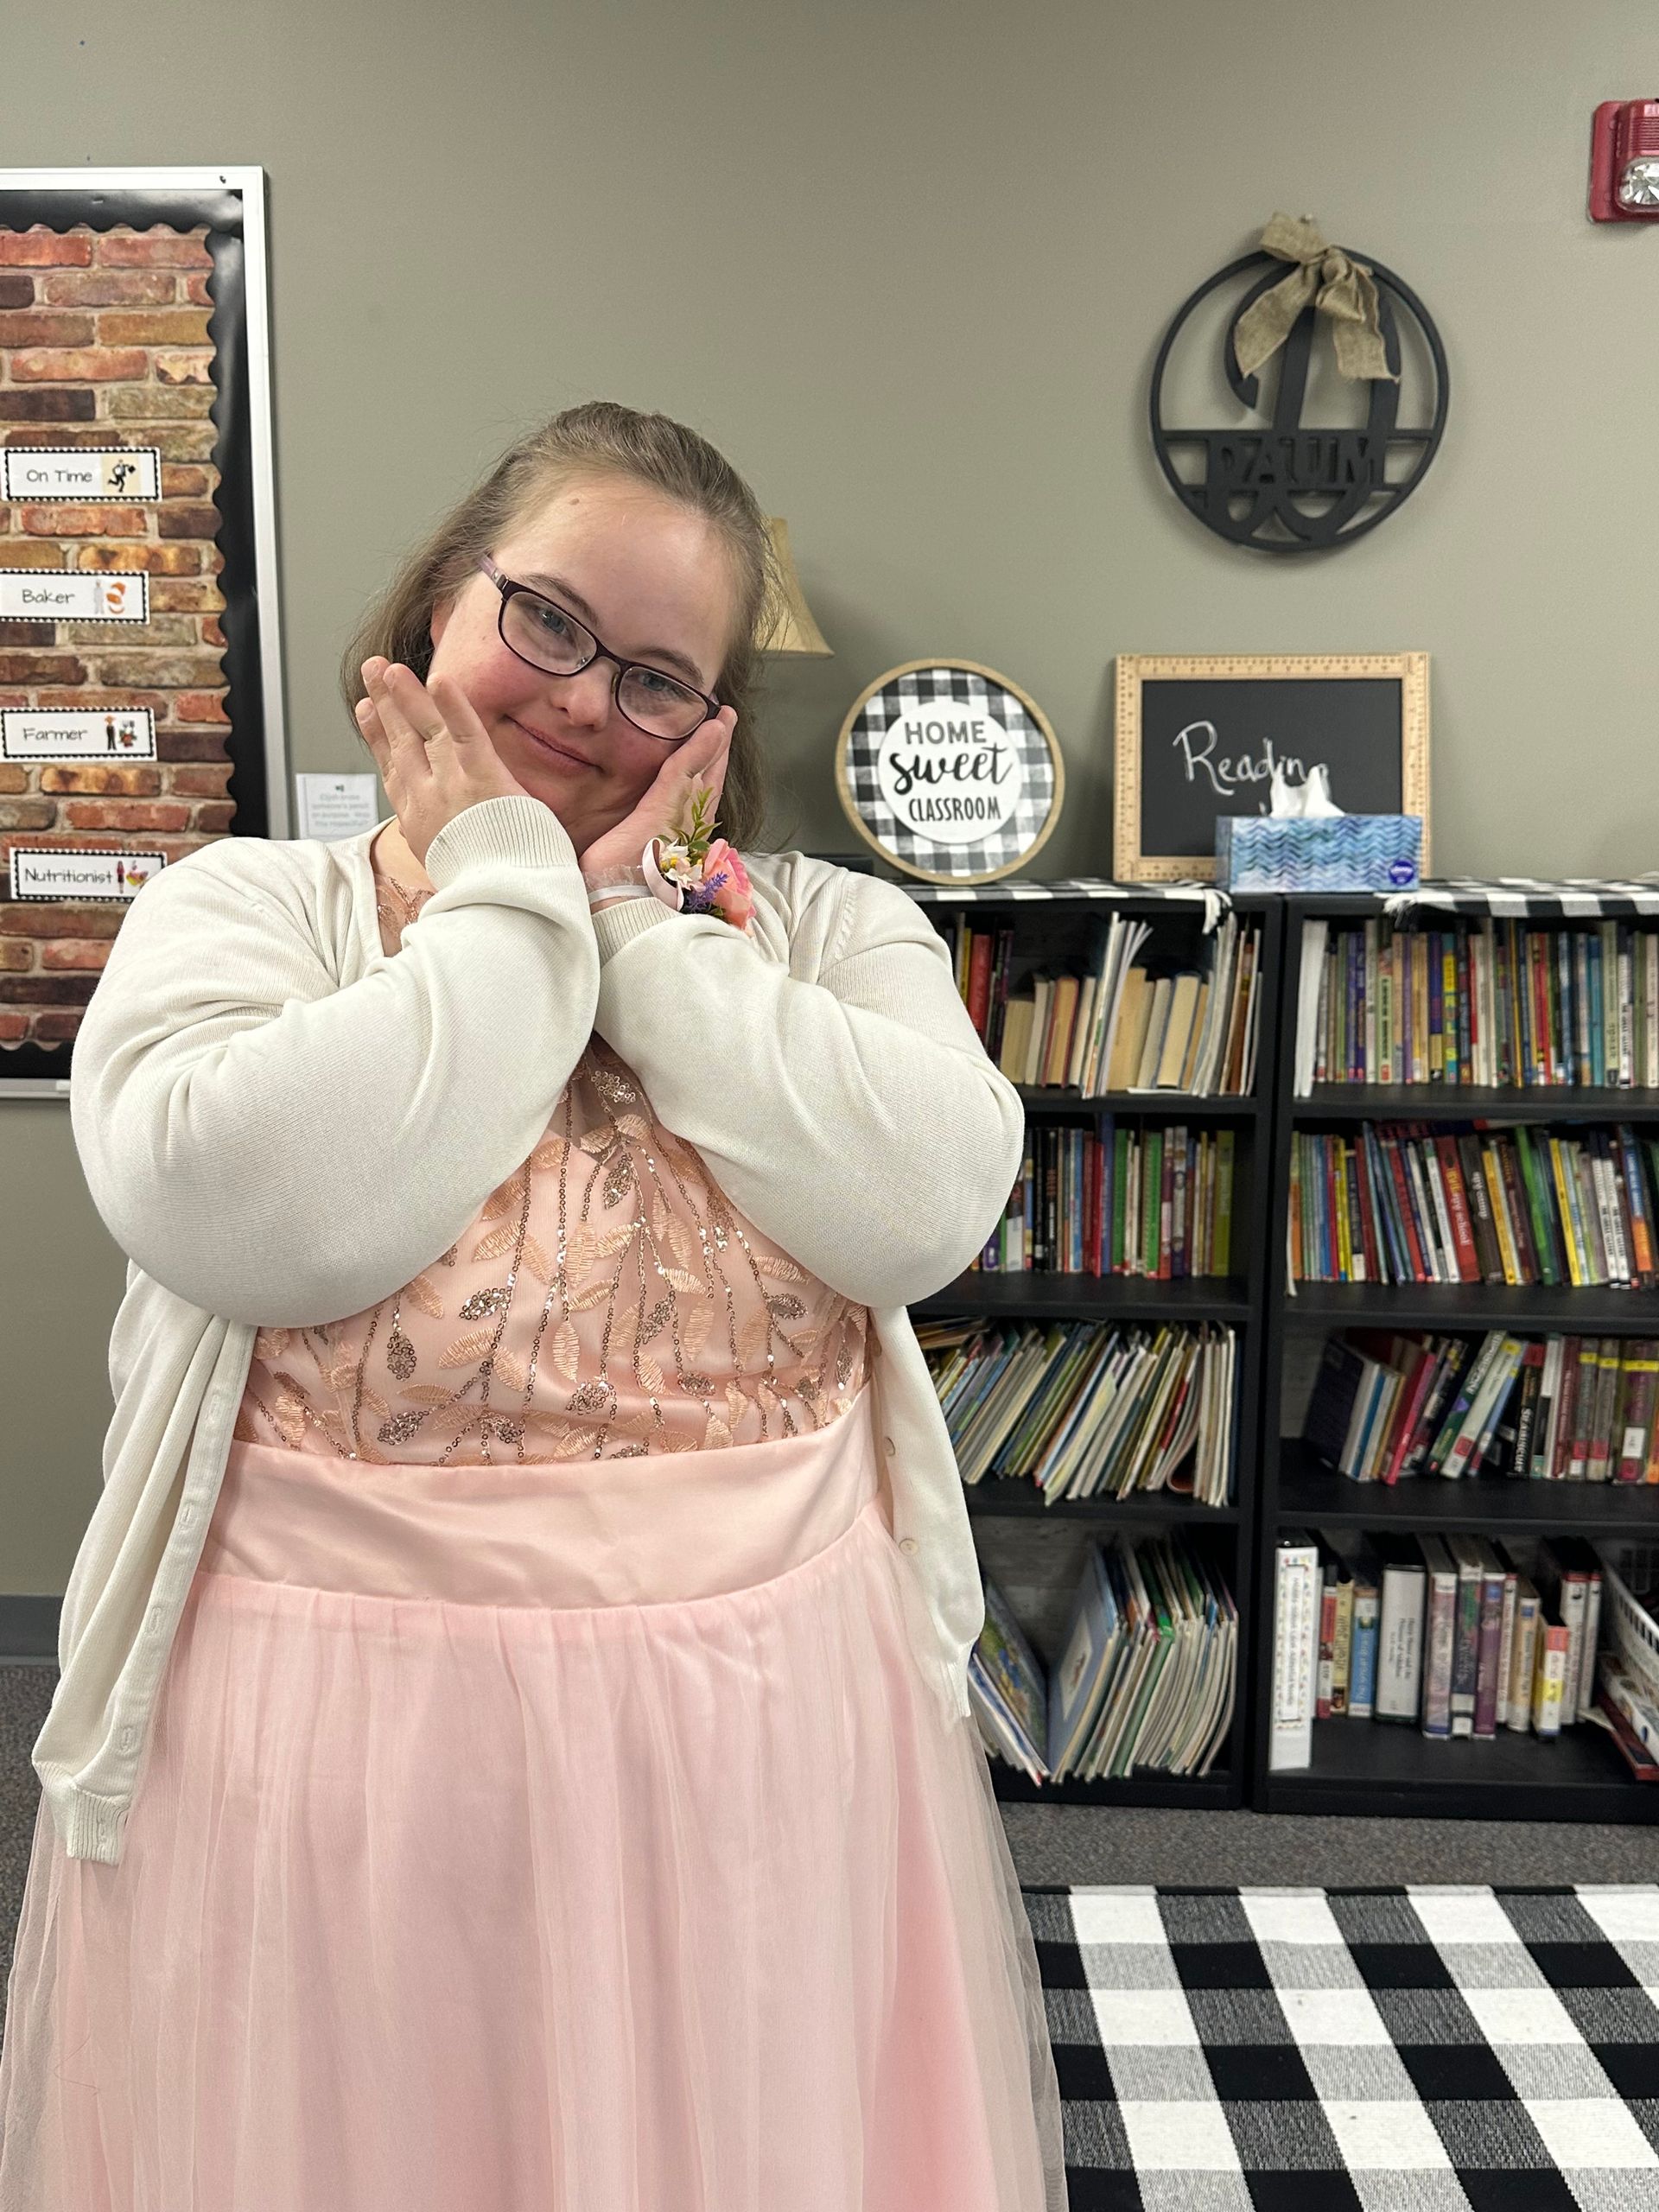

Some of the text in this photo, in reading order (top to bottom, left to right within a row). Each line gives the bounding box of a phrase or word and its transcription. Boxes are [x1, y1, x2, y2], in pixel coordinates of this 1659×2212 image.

[26, 469, 92, 482] On Time
[22, 588, 75, 603] Baker
[23, 727, 88, 742] Farmer
[905, 721, 987, 745] HOME
[889, 742, 1014, 795] sweet
[909, 796, 1001, 822] CLASSROOM
[25, 868, 113, 884] Nutritionist
